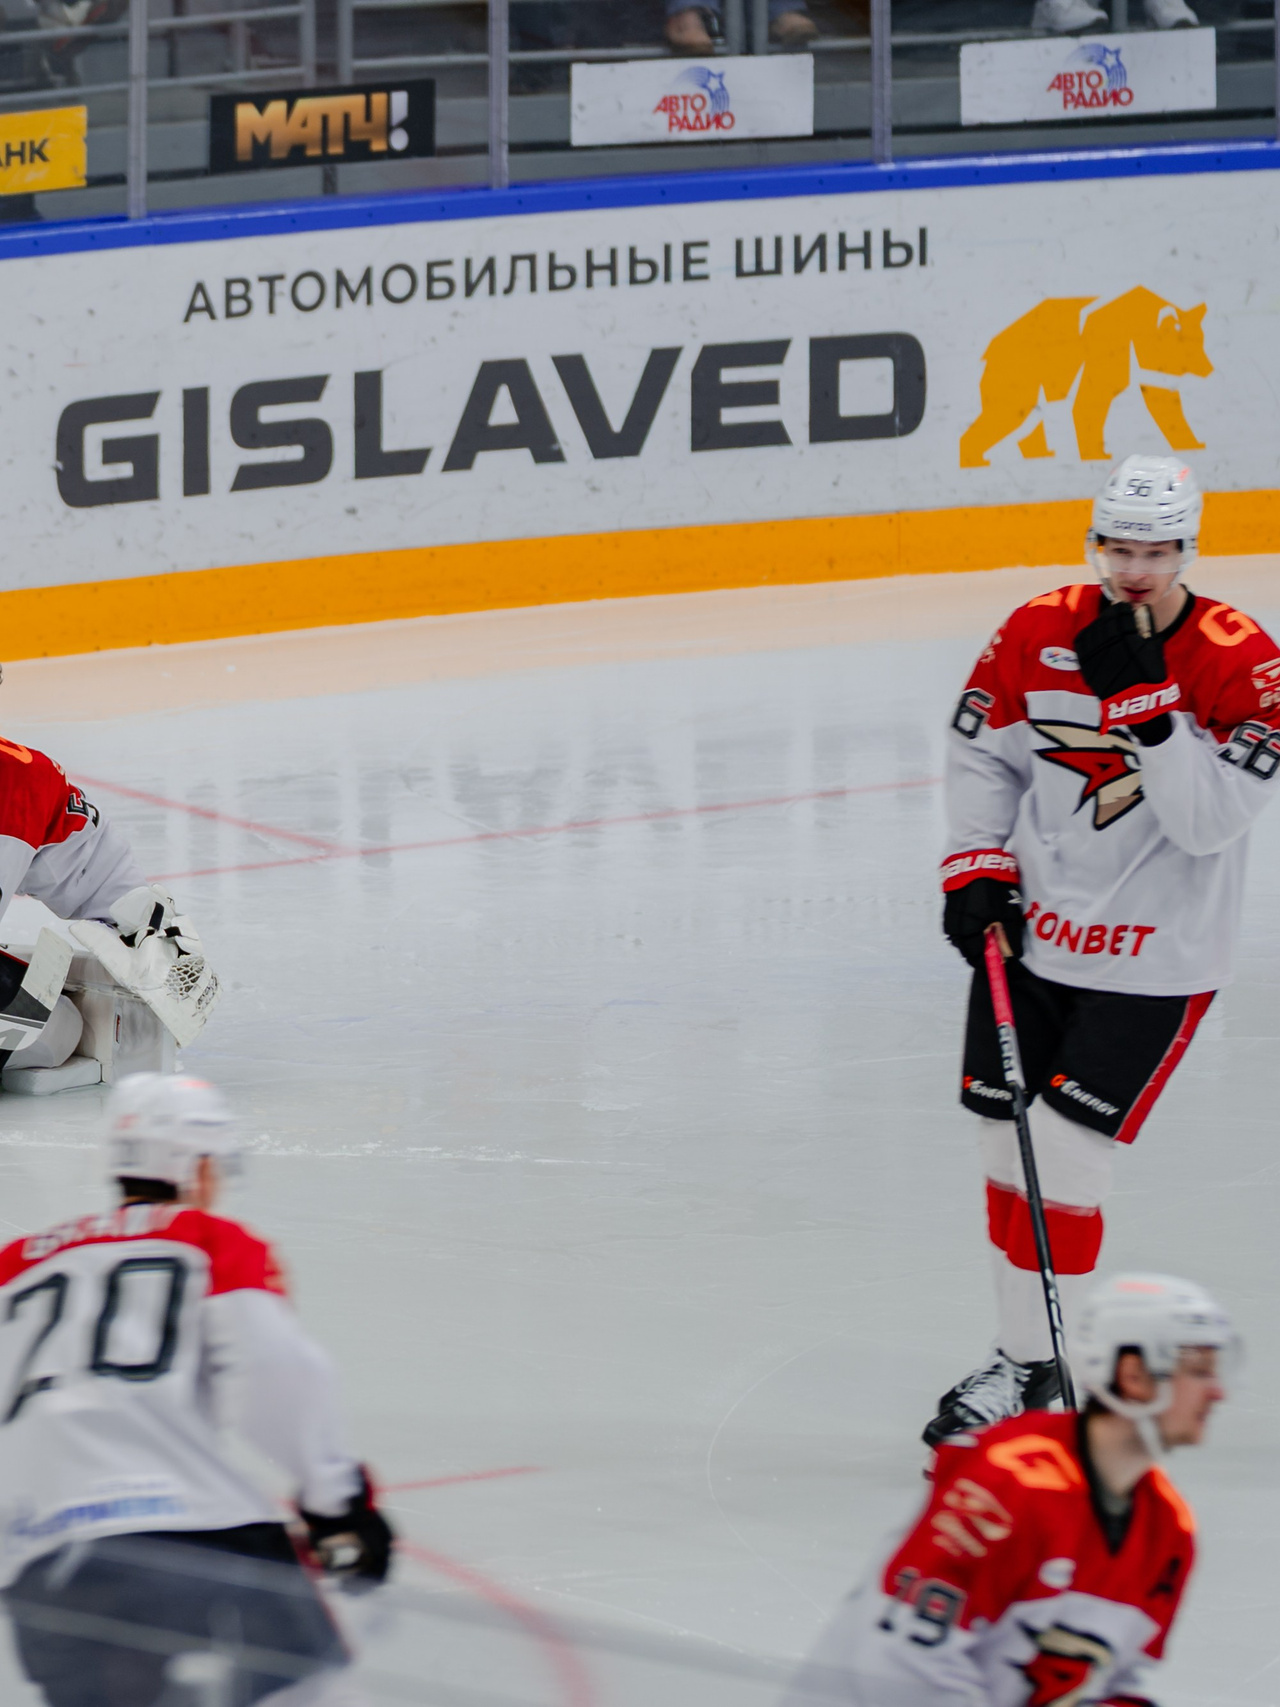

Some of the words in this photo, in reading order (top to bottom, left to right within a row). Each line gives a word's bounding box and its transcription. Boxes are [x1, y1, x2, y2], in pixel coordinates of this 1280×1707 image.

[1046, 70, 1103, 92] АВТО
[652, 93, 708, 114] АВТО
[1063, 87, 1134, 110] РАДИО
[235, 91, 409, 161] МАТЧ!
[668, 111, 736, 133] РАДИО
[183, 240, 710, 323] АВТОМОБИЛЬНЫЕ
[734, 226, 928, 279] ШИНЫ
[56, 331, 927, 509] GISLAVED
[1124, 478, 1153, 497] 56
[1, 1256, 188, 1427] 20
